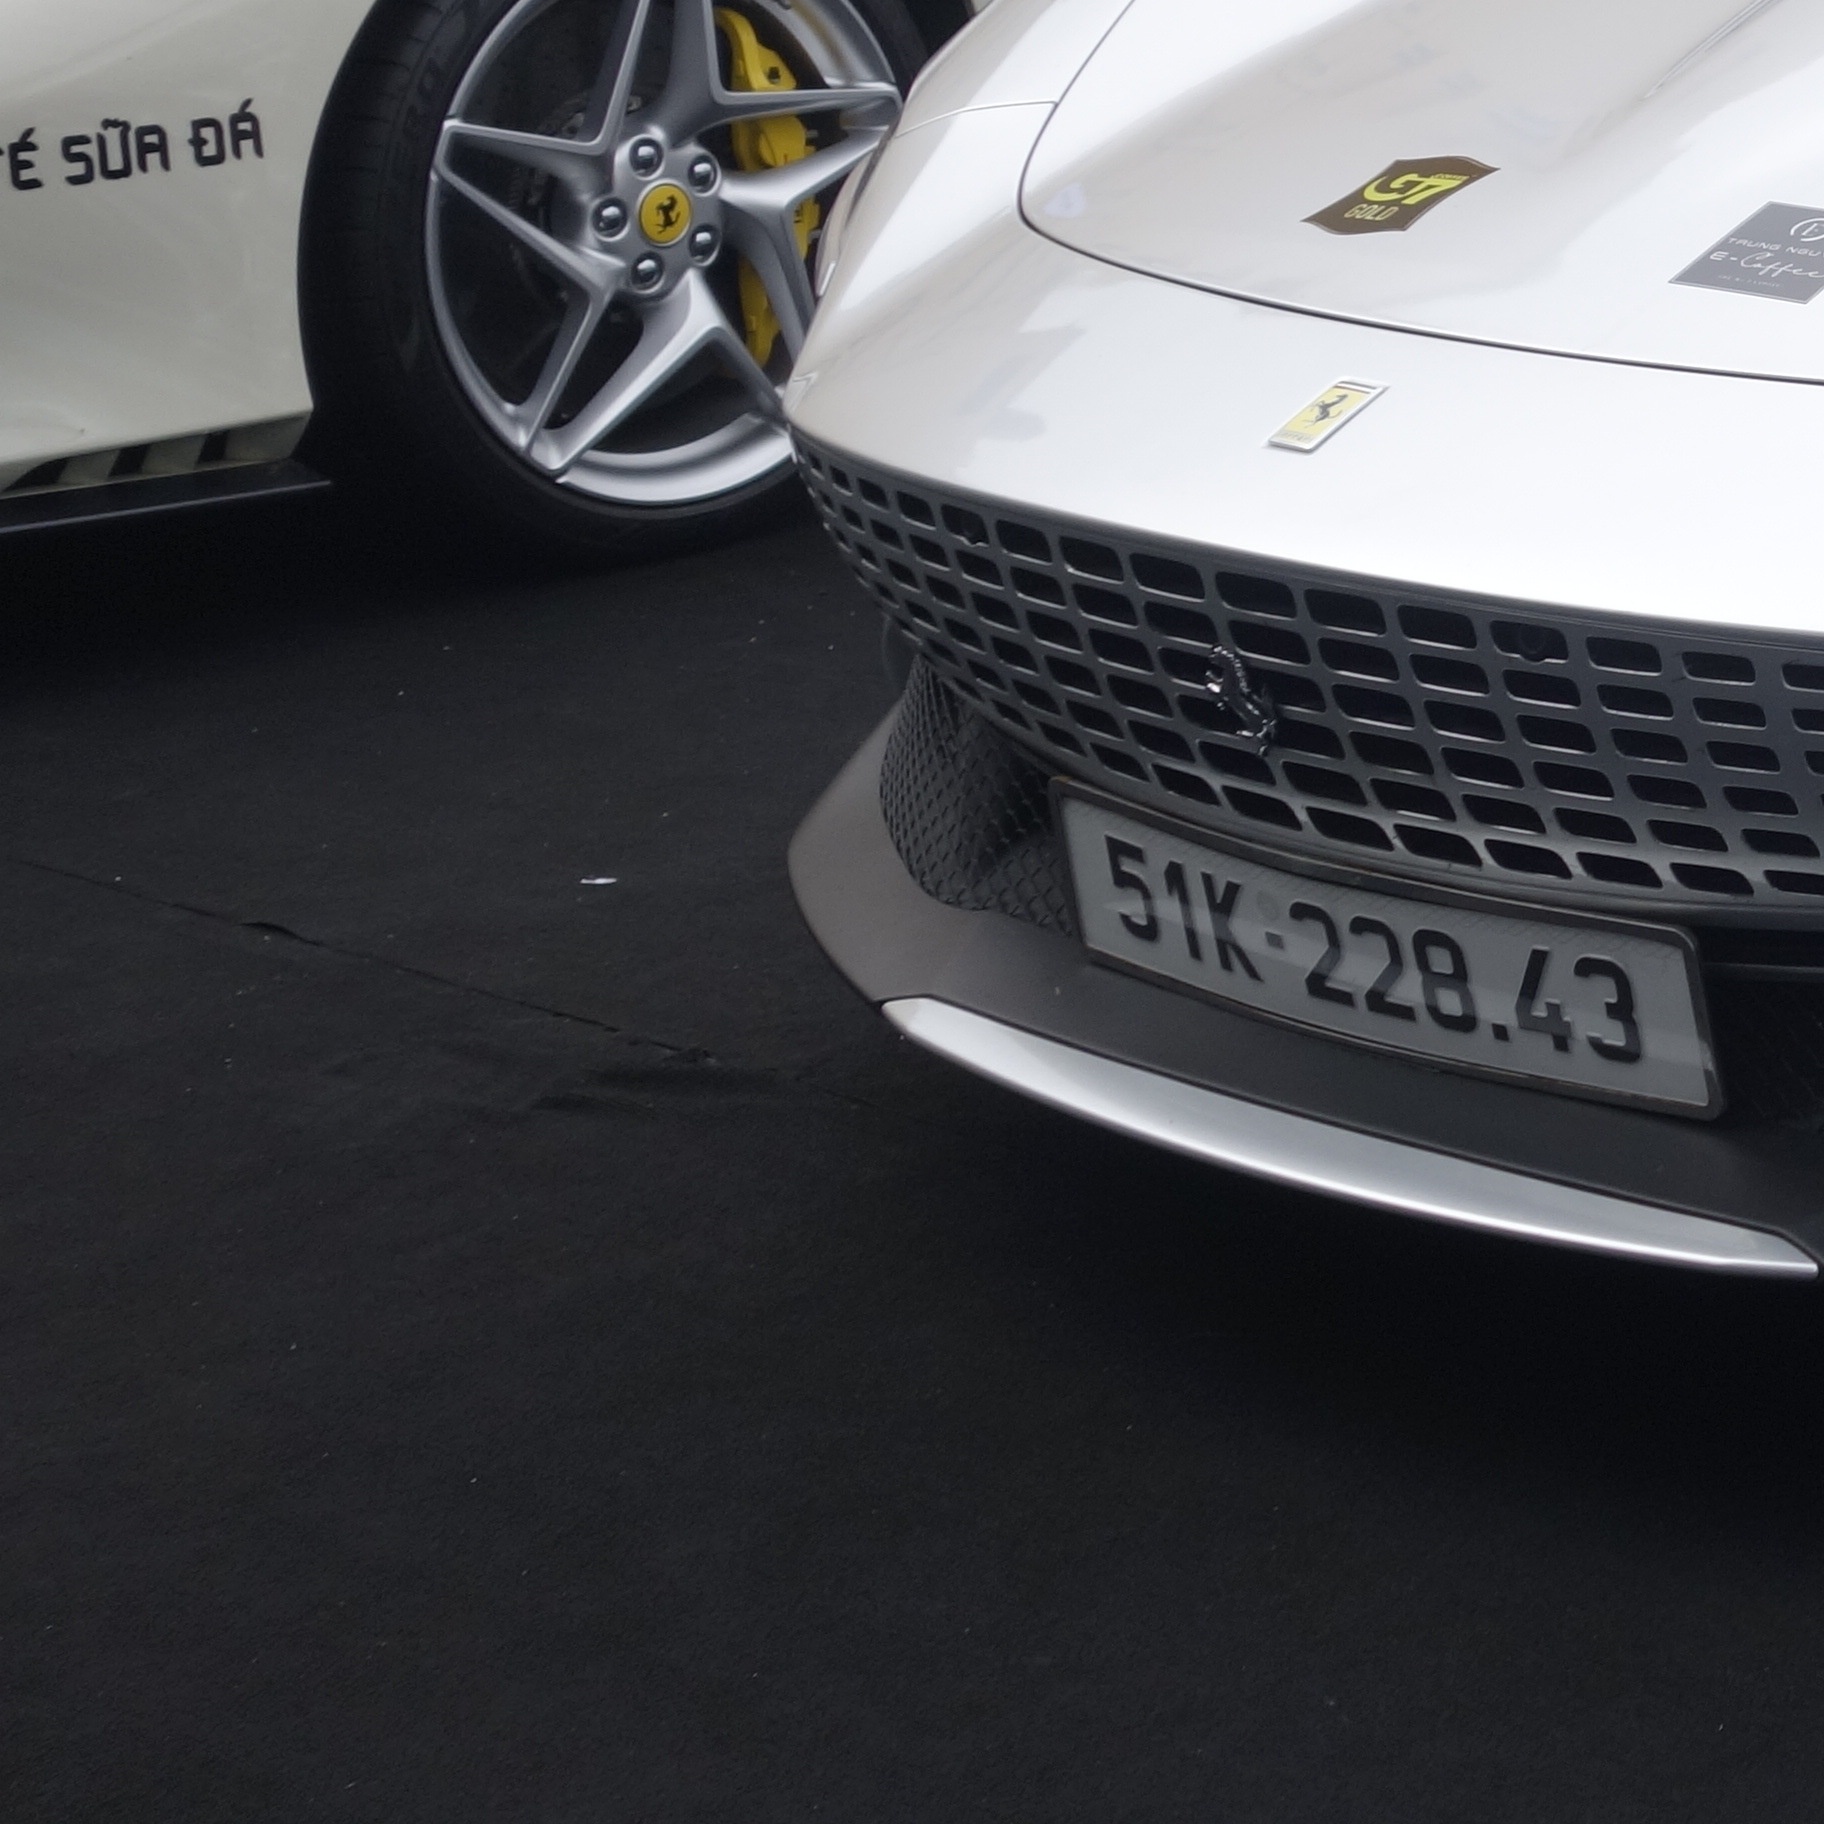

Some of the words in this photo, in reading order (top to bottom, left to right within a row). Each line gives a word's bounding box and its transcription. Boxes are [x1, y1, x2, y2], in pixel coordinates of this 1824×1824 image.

[60, 118, 171, 186] SỮA
[188, 97, 264, 168] ĐÁ
[1343, 203, 1400, 221] GOLD
[1727, 236, 1782, 251] TRUNG
